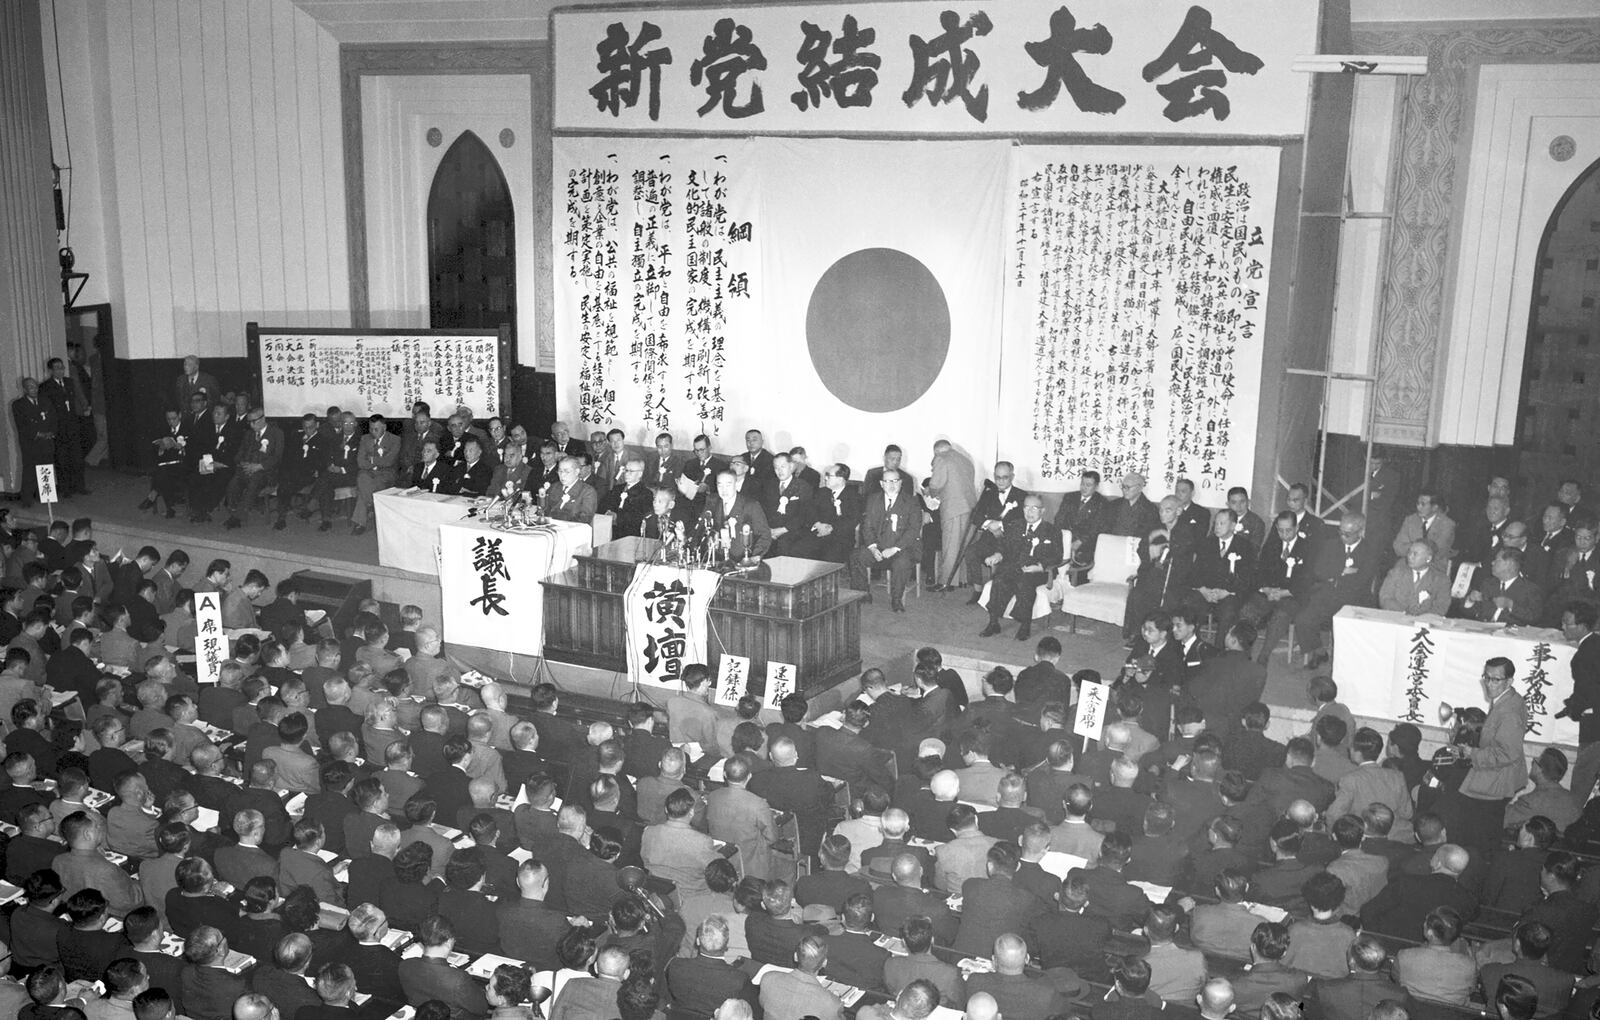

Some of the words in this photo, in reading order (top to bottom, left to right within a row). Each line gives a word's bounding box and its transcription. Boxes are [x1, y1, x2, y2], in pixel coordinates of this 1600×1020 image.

[588, 5, 1264, 122] 新党結成大会
[727, 221, 752, 299] 綱領
[1239, 226, 1264, 339] 立党宣言
[470, 536, 511, 617] 議長
[643, 580, 695, 682] 演壇
[1398, 627, 1434, 723] 大会運営委員長
[722, 658, 742, 701] 記録係
